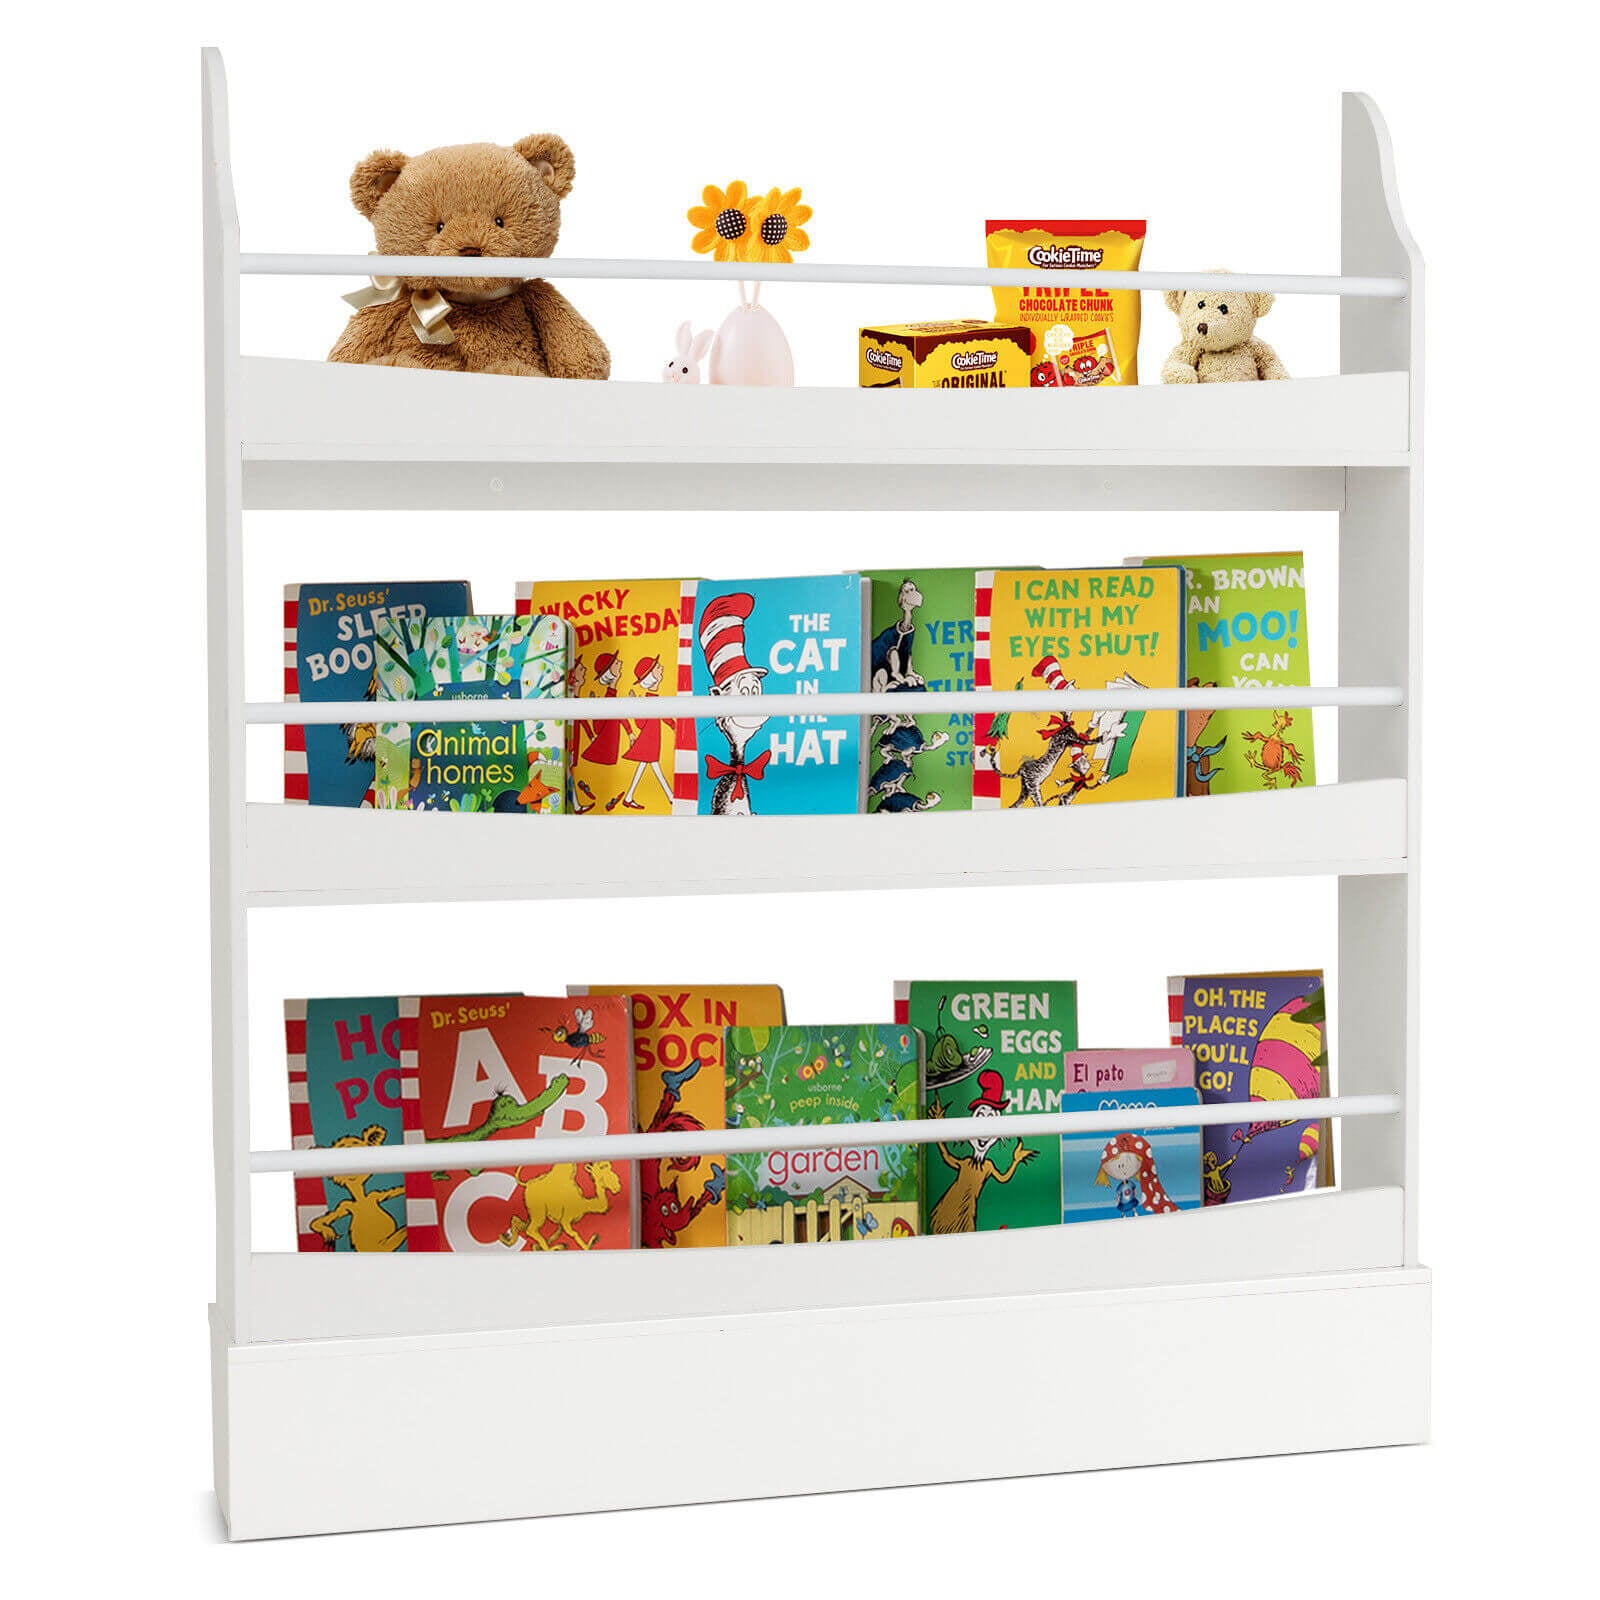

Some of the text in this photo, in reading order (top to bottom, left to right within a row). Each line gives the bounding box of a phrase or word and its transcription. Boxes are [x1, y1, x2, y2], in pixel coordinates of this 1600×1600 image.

[1029, 246, 1102, 264] CookieTime
[1019, 299, 1113, 311] CHOCOLATE CHUNK
[866, 349, 902, 367] CookieTime
[952, 352, 997, 369] CookieTime
[942, 371, 1006, 388] ORIGINAL
[1014, 576, 1154, 601] I CAN READ
[1184, 565, 1305, 590] R. BROWN
[308, 587, 390, 616] Dr. Seuss'
[539, 588, 630, 620] WACKY
[1187, 595, 1220, 614] AN
[575, 607, 681, 647] DNESDA
[789, 613, 830, 633] THE
[1024, 605, 1139, 629] WITH MY
[925, 620, 974, 645] YER
[1197, 608, 1299, 652] MOO!
[769, 638, 847, 674] CAT
[1009, 632, 1160, 659] EYES SHUT!
[305, 643, 376, 682] BOO
[1240, 653, 1289, 672] CAN
[796, 679, 819, 695] IN
[948, 713, 974, 726] AN
[416, 724, 517, 757] animal
[769, 729, 847, 766] HAT
[426, 758, 514, 785] homes
[951, 992, 1049, 1021] GREEN
[1193, 987, 1267, 1010] OH, THE
[430, 1002, 510, 1029] Dr. Seuss'
[631, 993, 737, 1030] OX IN
[1184, 1015, 1258, 1037] PLACES
[634, 1033, 724, 1071] SOC
[1001, 1030, 1062, 1054] EGGS
[1014, 1062, 1057, 1082] AND
[1073, 1063, 1088, 1082] El
[1096, 1065, 1124, 1087] pato
[1199, 1071, 1234, 1092] GO!
[808, 1082, 842, 1092] usborne
[789, 1093, 860, 1113] peep inside
[1004, 1088, 1062, 1113] HAM
[768, 1146, 879, 1186] garden
